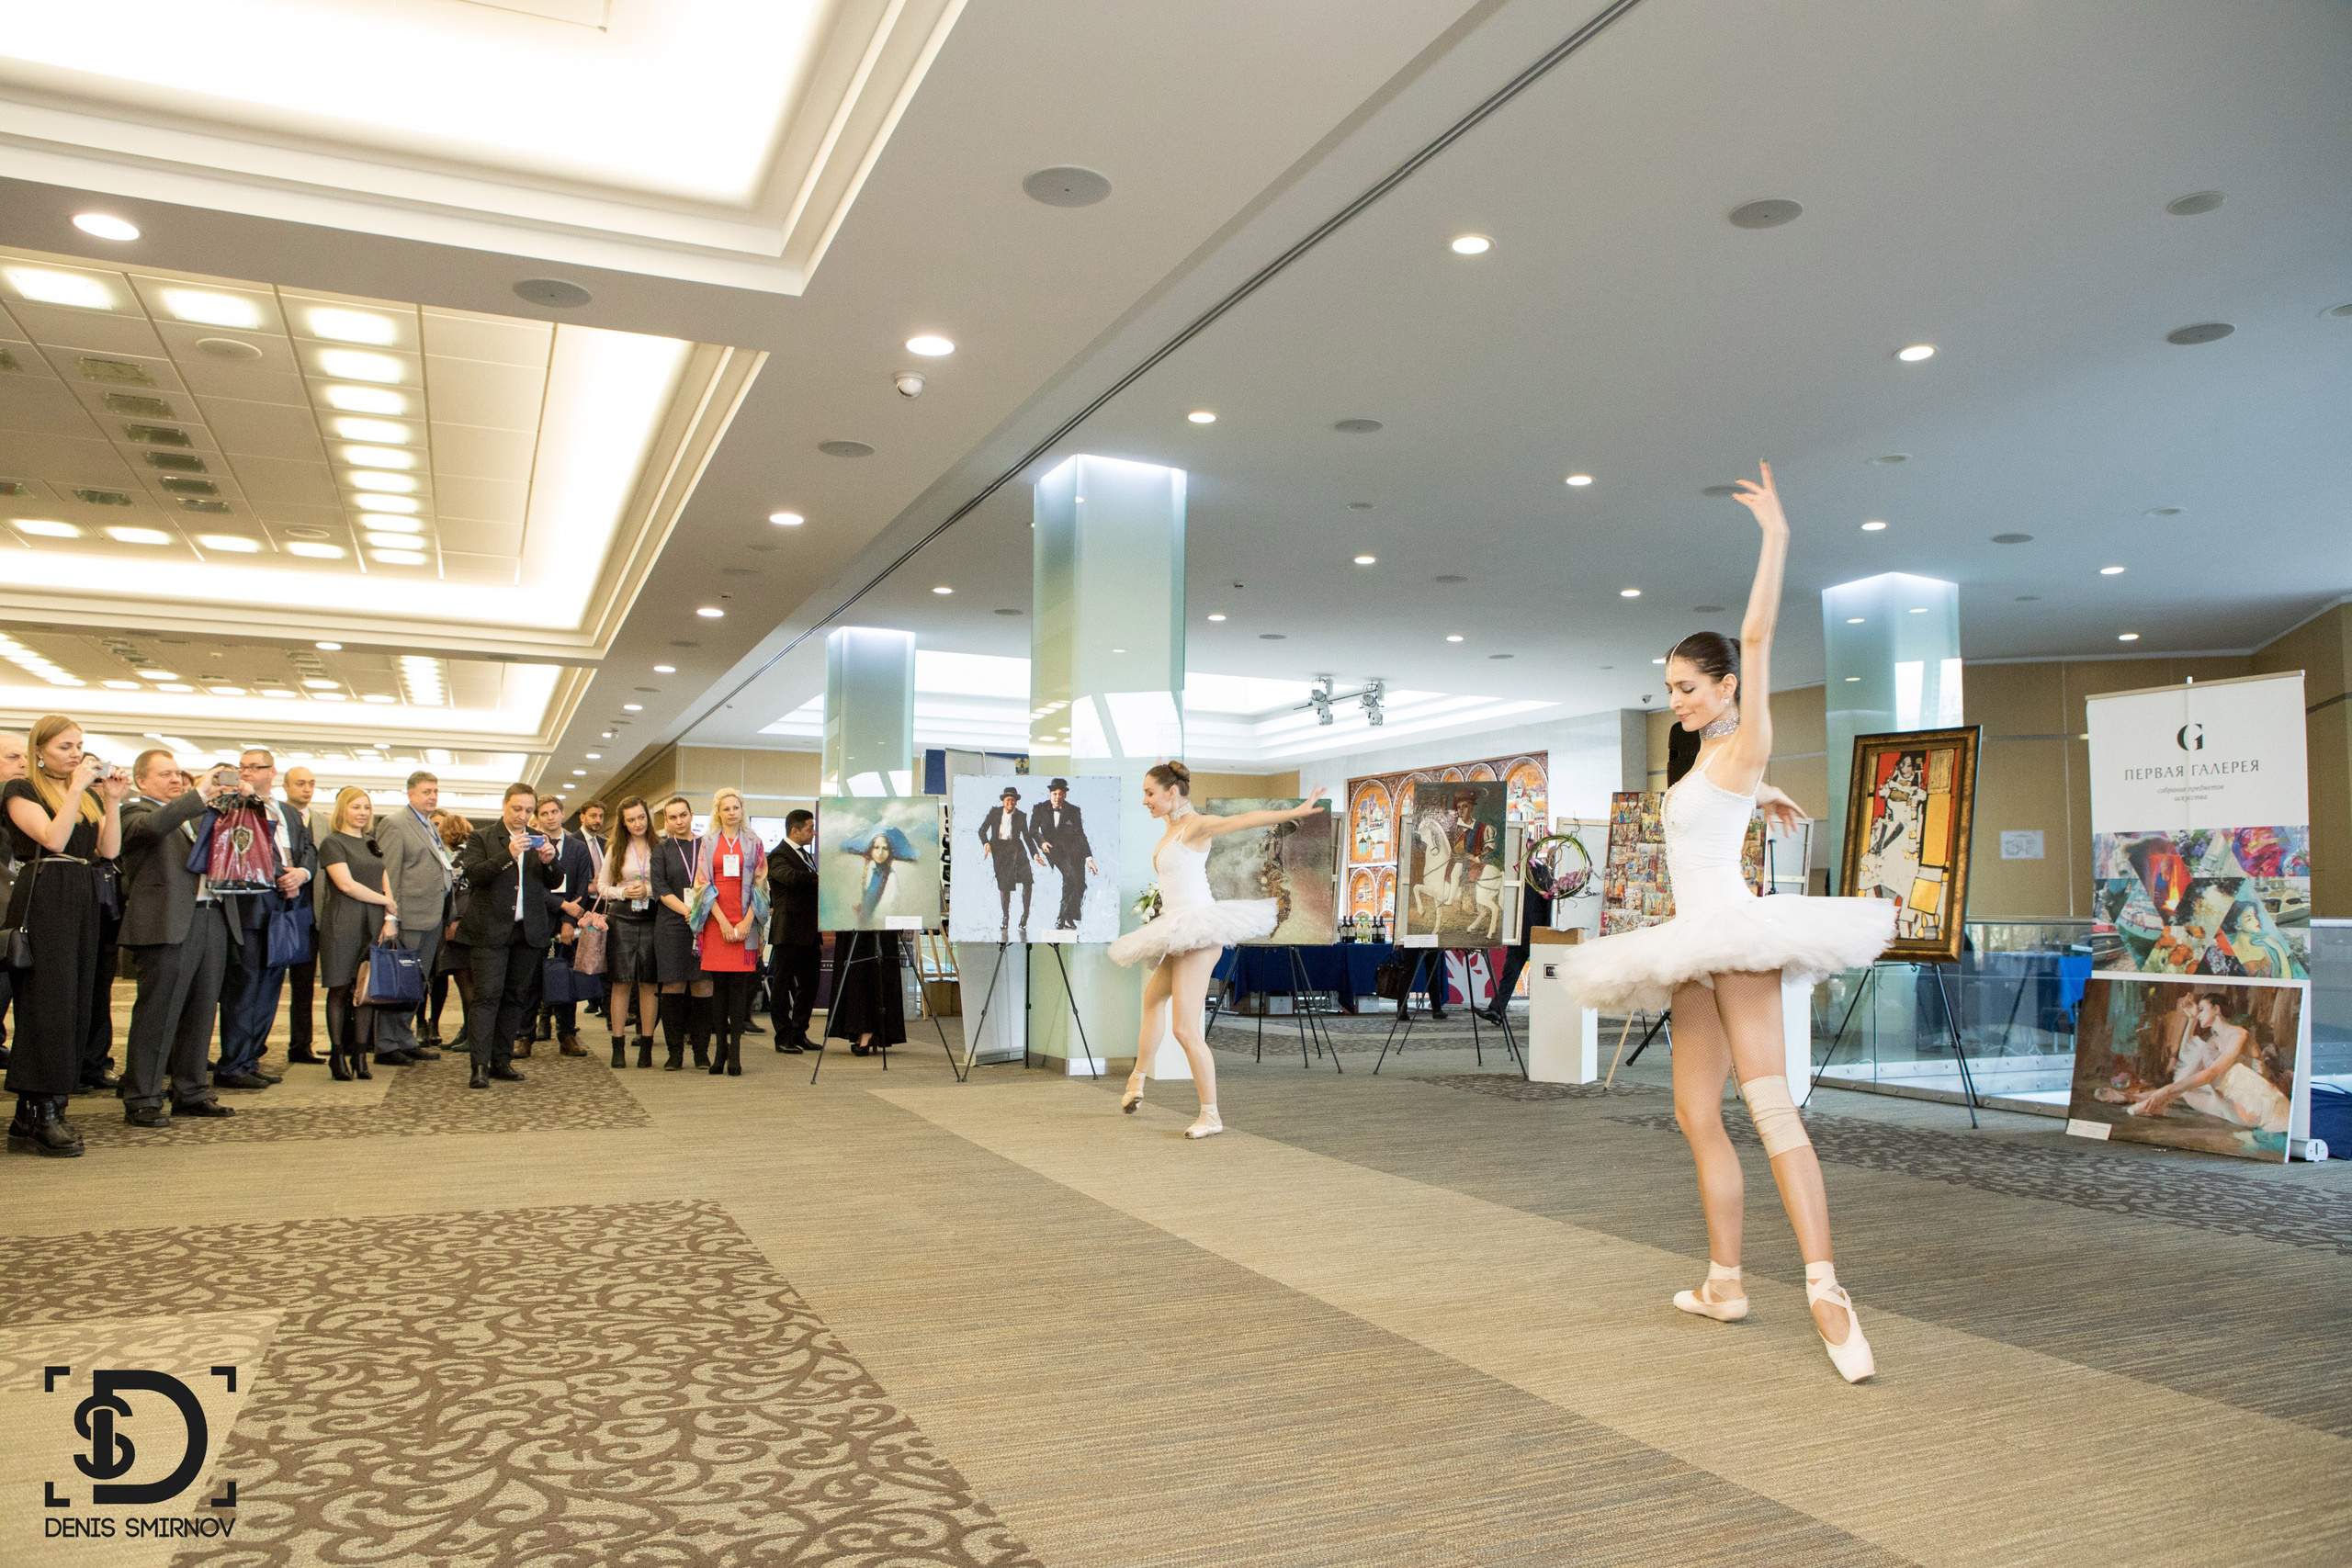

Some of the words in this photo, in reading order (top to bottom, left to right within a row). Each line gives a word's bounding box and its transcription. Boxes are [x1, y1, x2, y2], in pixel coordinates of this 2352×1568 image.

[2177, 723, 2204, 751] G
[2124, 765, 2185, 781] ПЕРВАЯ
[2191, 760, 2260, 776] ГАЛЕРЕЯ
